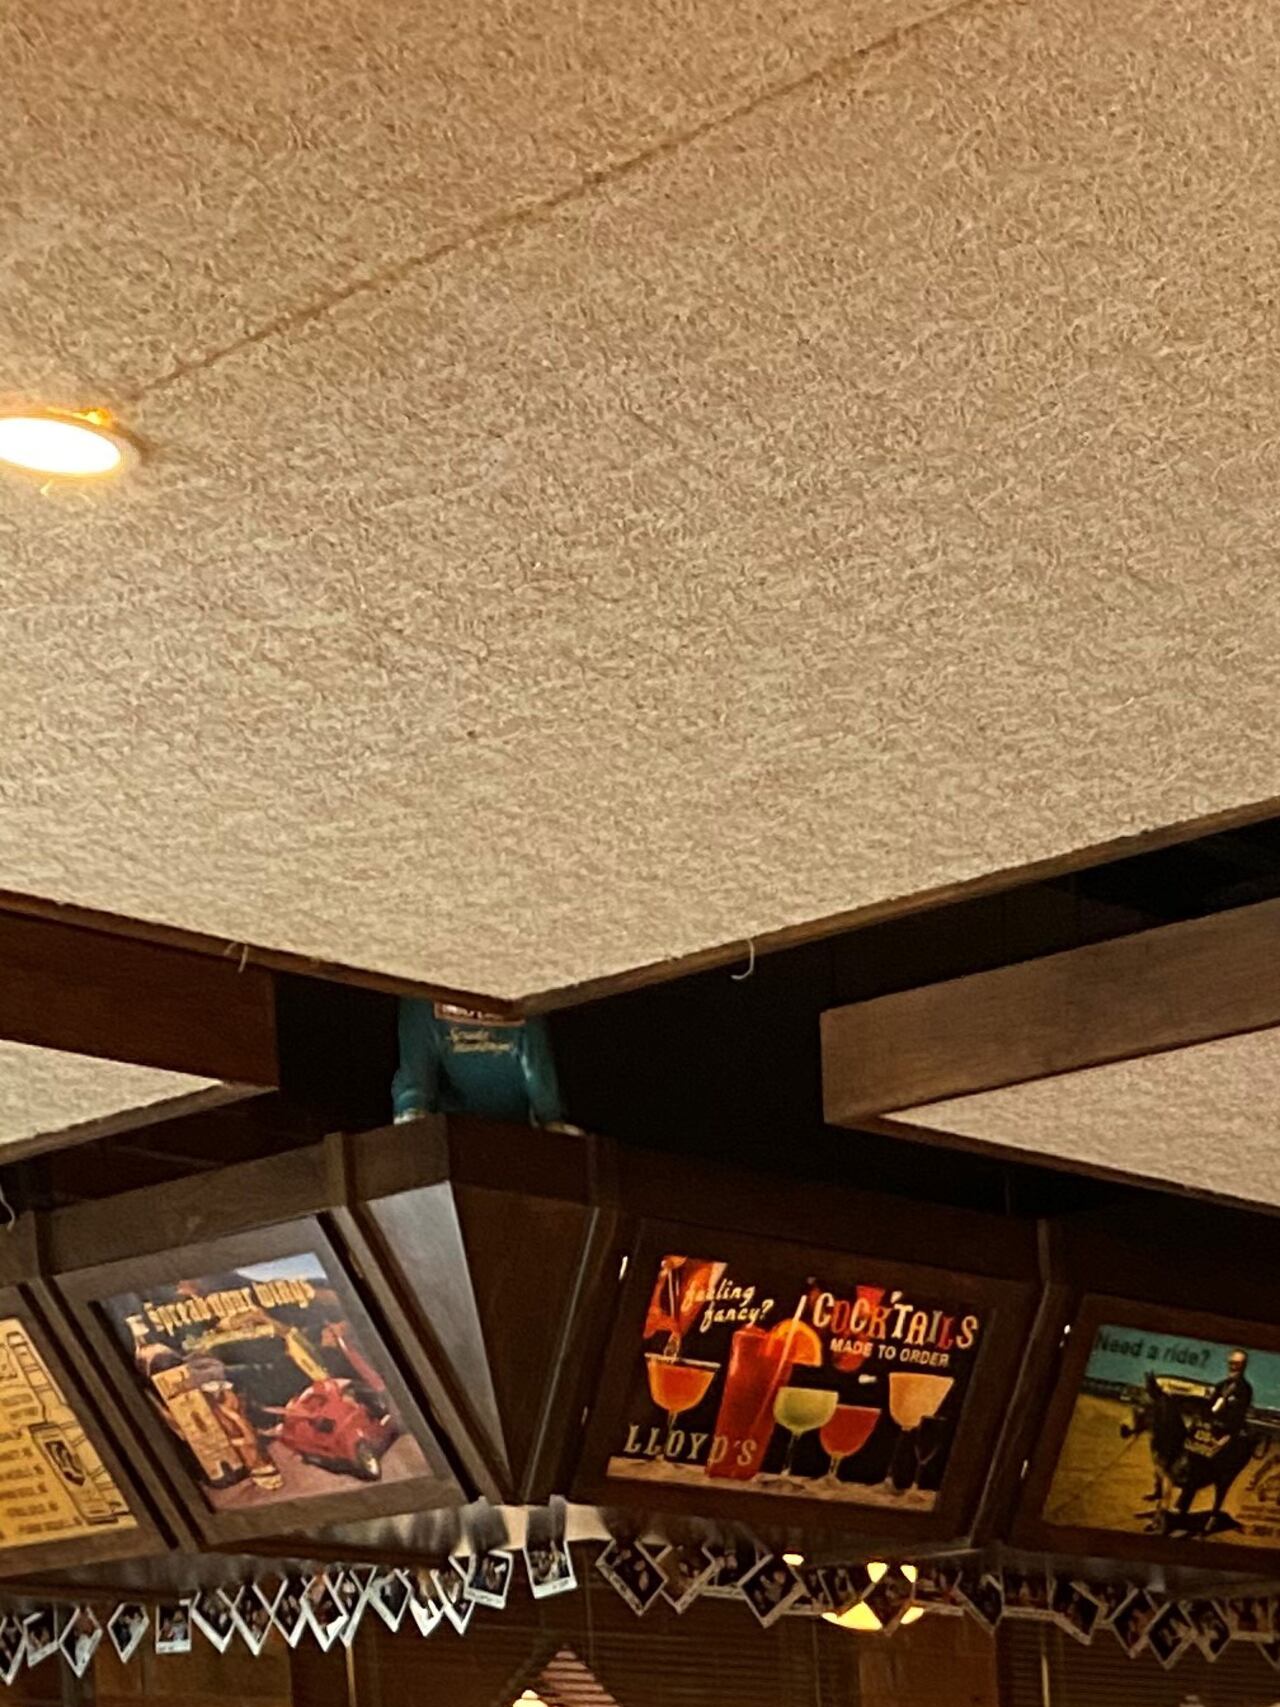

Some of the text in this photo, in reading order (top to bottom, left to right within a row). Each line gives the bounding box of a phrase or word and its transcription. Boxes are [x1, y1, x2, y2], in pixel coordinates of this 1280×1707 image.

[812, 1291, 979, 1350] COCKTAILS
[830, 1337, 950, 1368] MADE TO ORDER
[1096, 1334, 1143, 1358] Need
[1162, 1344, 1212, 1369] ride?
[624, 1424, 757, 1467] LLOYD'S
